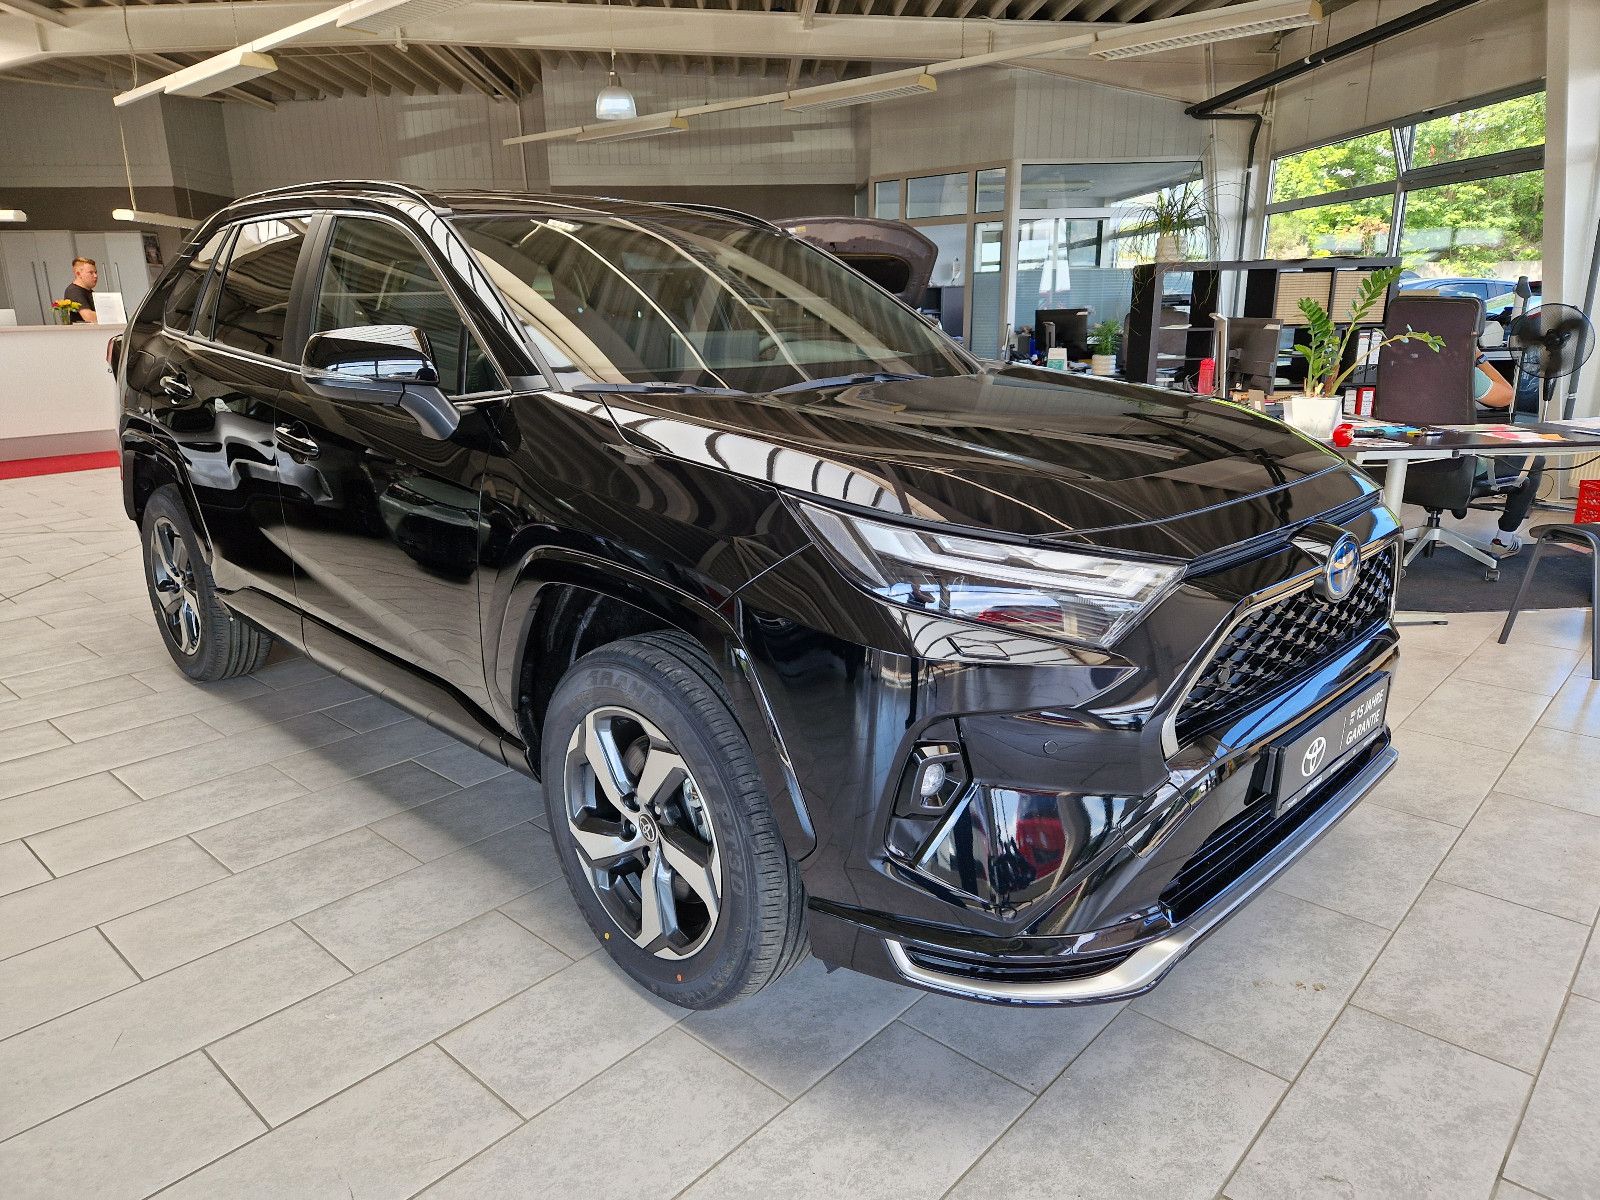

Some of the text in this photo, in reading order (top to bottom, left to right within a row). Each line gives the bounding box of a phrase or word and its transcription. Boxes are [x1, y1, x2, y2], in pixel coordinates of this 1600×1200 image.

[1356, 703, 1365, 719] 15
[1364, 688, 1385, 714] JAHRE
[1346, 709, 1381, 745] GARANTIE
